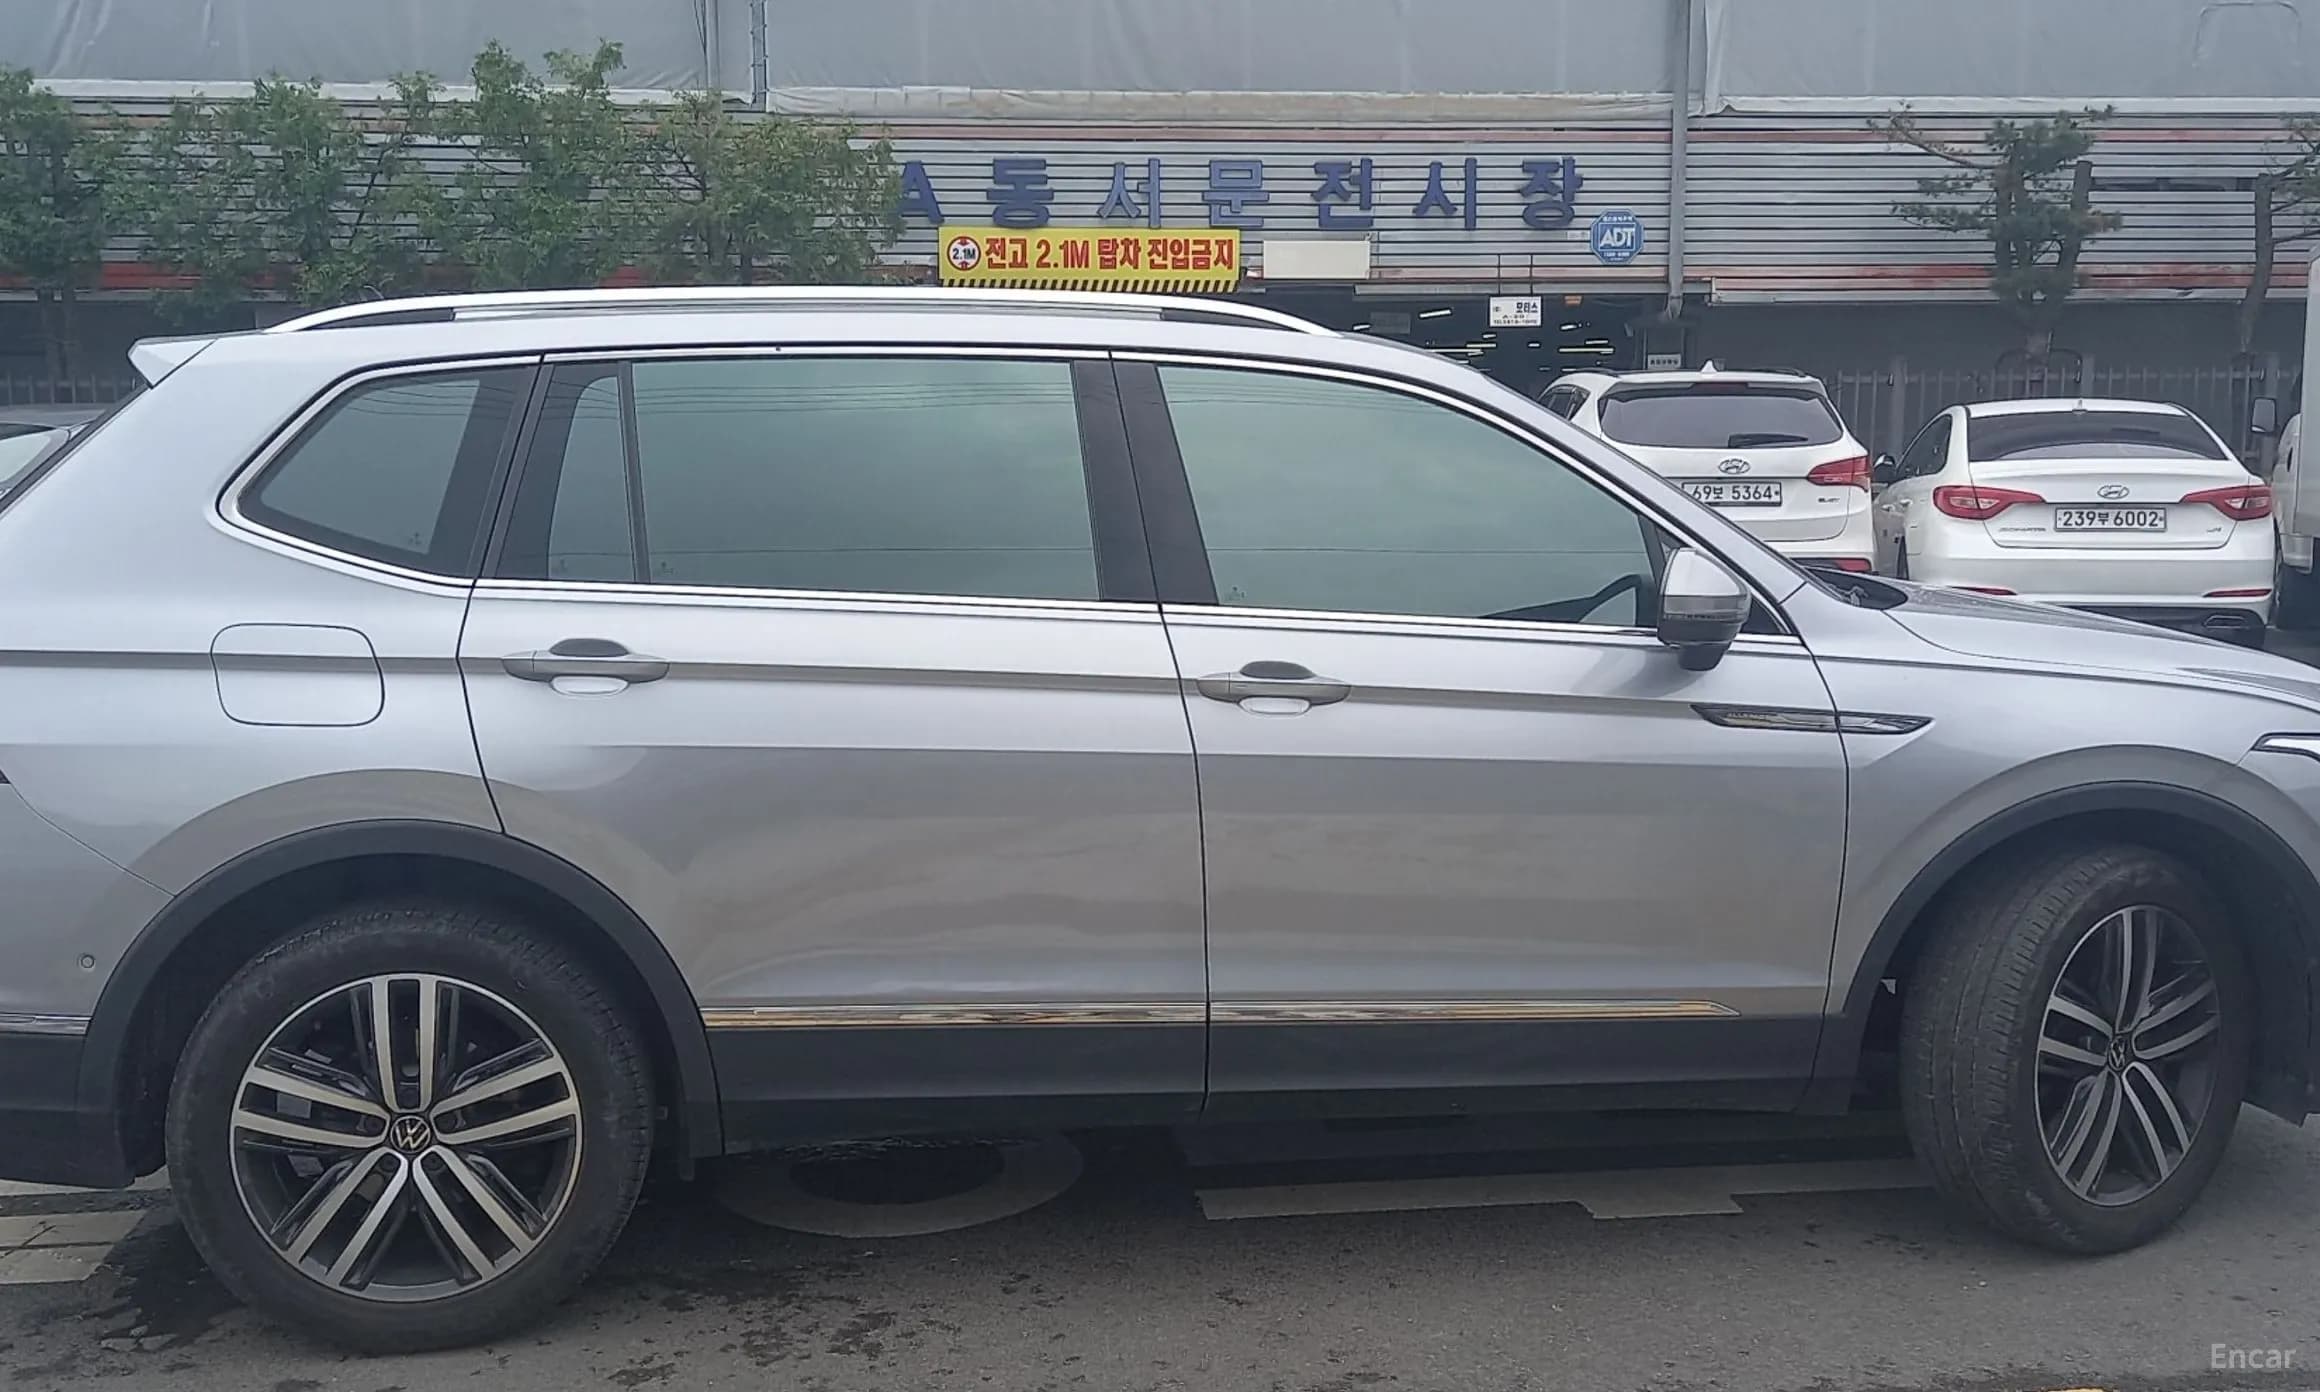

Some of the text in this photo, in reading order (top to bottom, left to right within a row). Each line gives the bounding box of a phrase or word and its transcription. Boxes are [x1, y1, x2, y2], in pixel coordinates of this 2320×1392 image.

[1600, 228, 1635, 247] ADT
[952, 247, 976, 260] 2.1M
[985, 237, 1234, 270] 전고 2.1M 탑차 진입금지
[1693, 485, 1772, 500] 69보 5364
[2113, 511, 2159, 527] 6002
